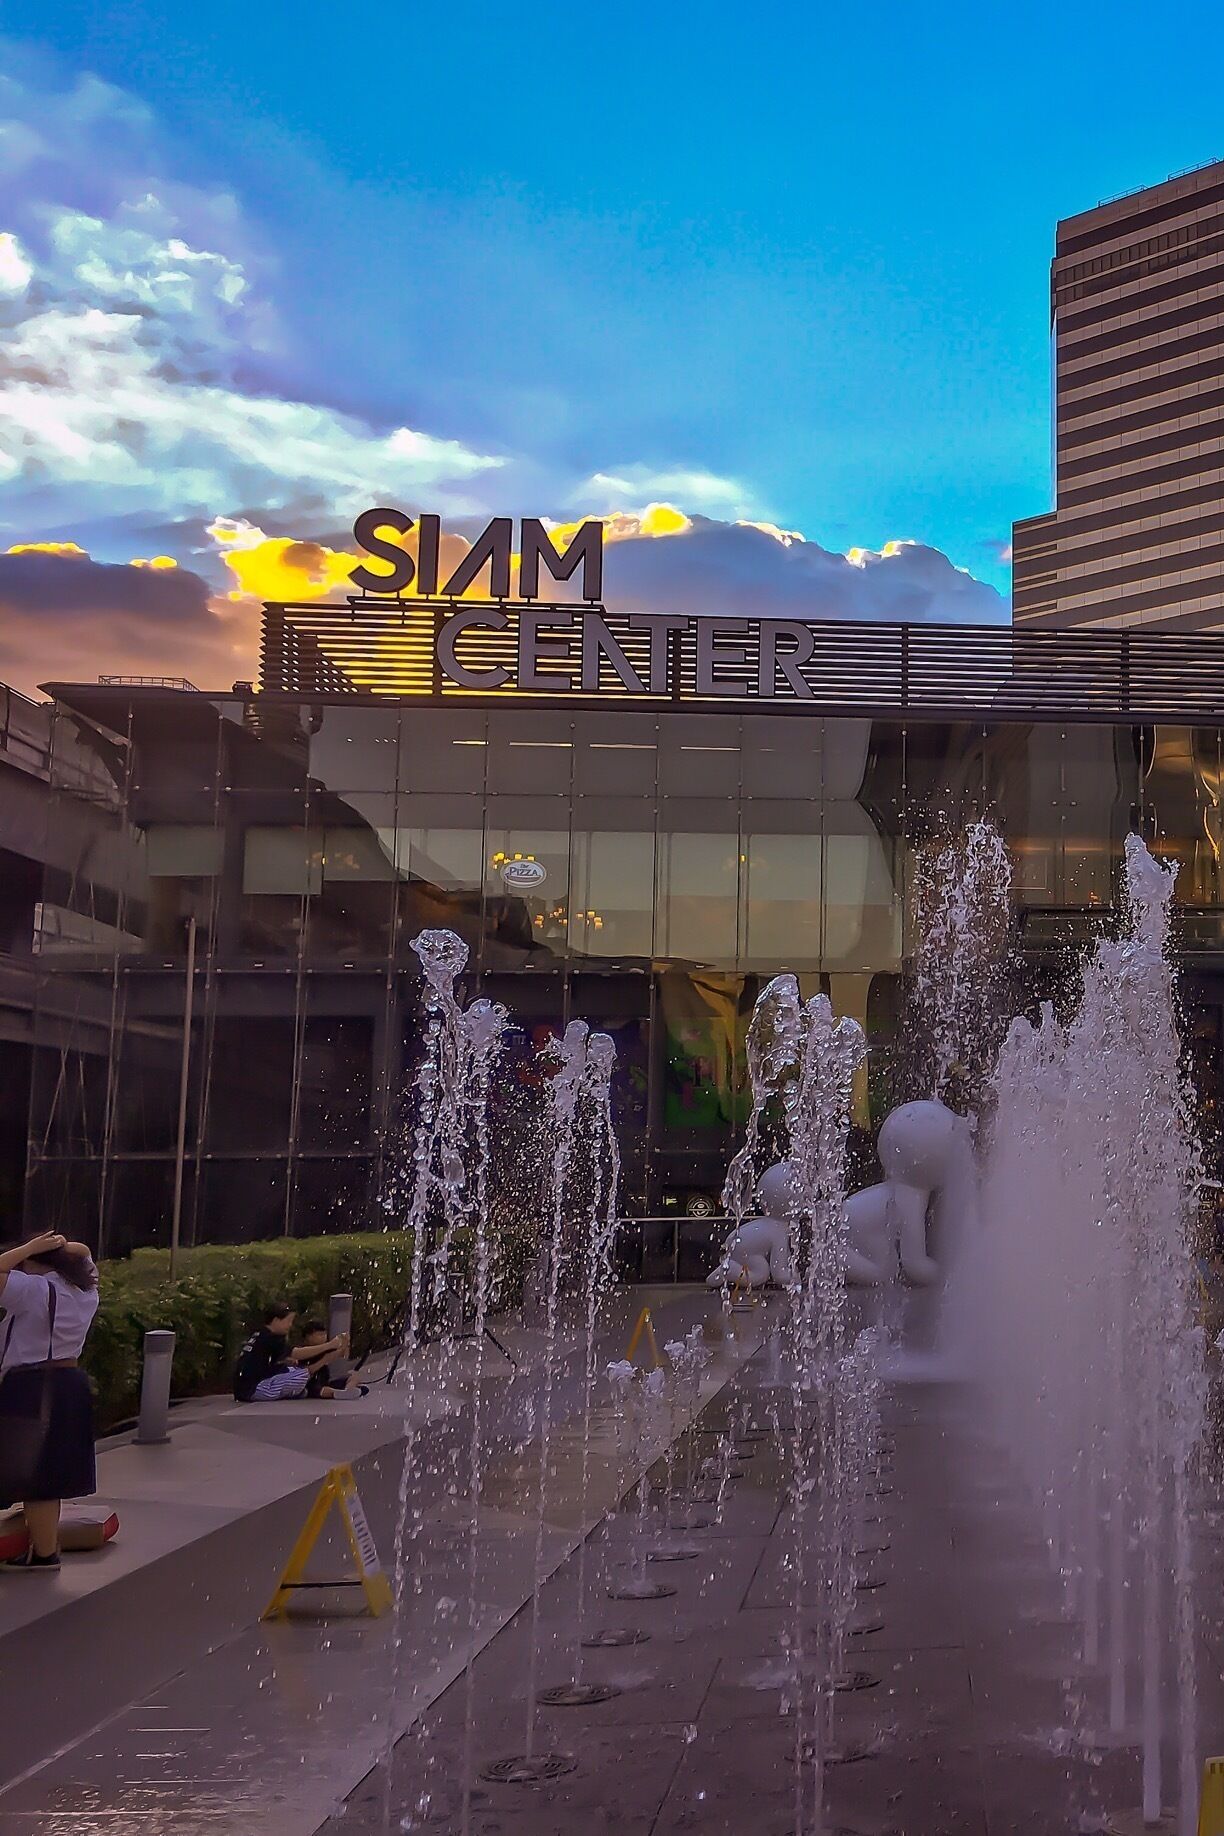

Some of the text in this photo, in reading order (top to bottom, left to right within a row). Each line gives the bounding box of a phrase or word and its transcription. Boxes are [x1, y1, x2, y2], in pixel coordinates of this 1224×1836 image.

[347, 507, 603, 602] SIAM
[436, 608, 816, 699] CENTER
[509, 867, 538, 876] PIZZA
